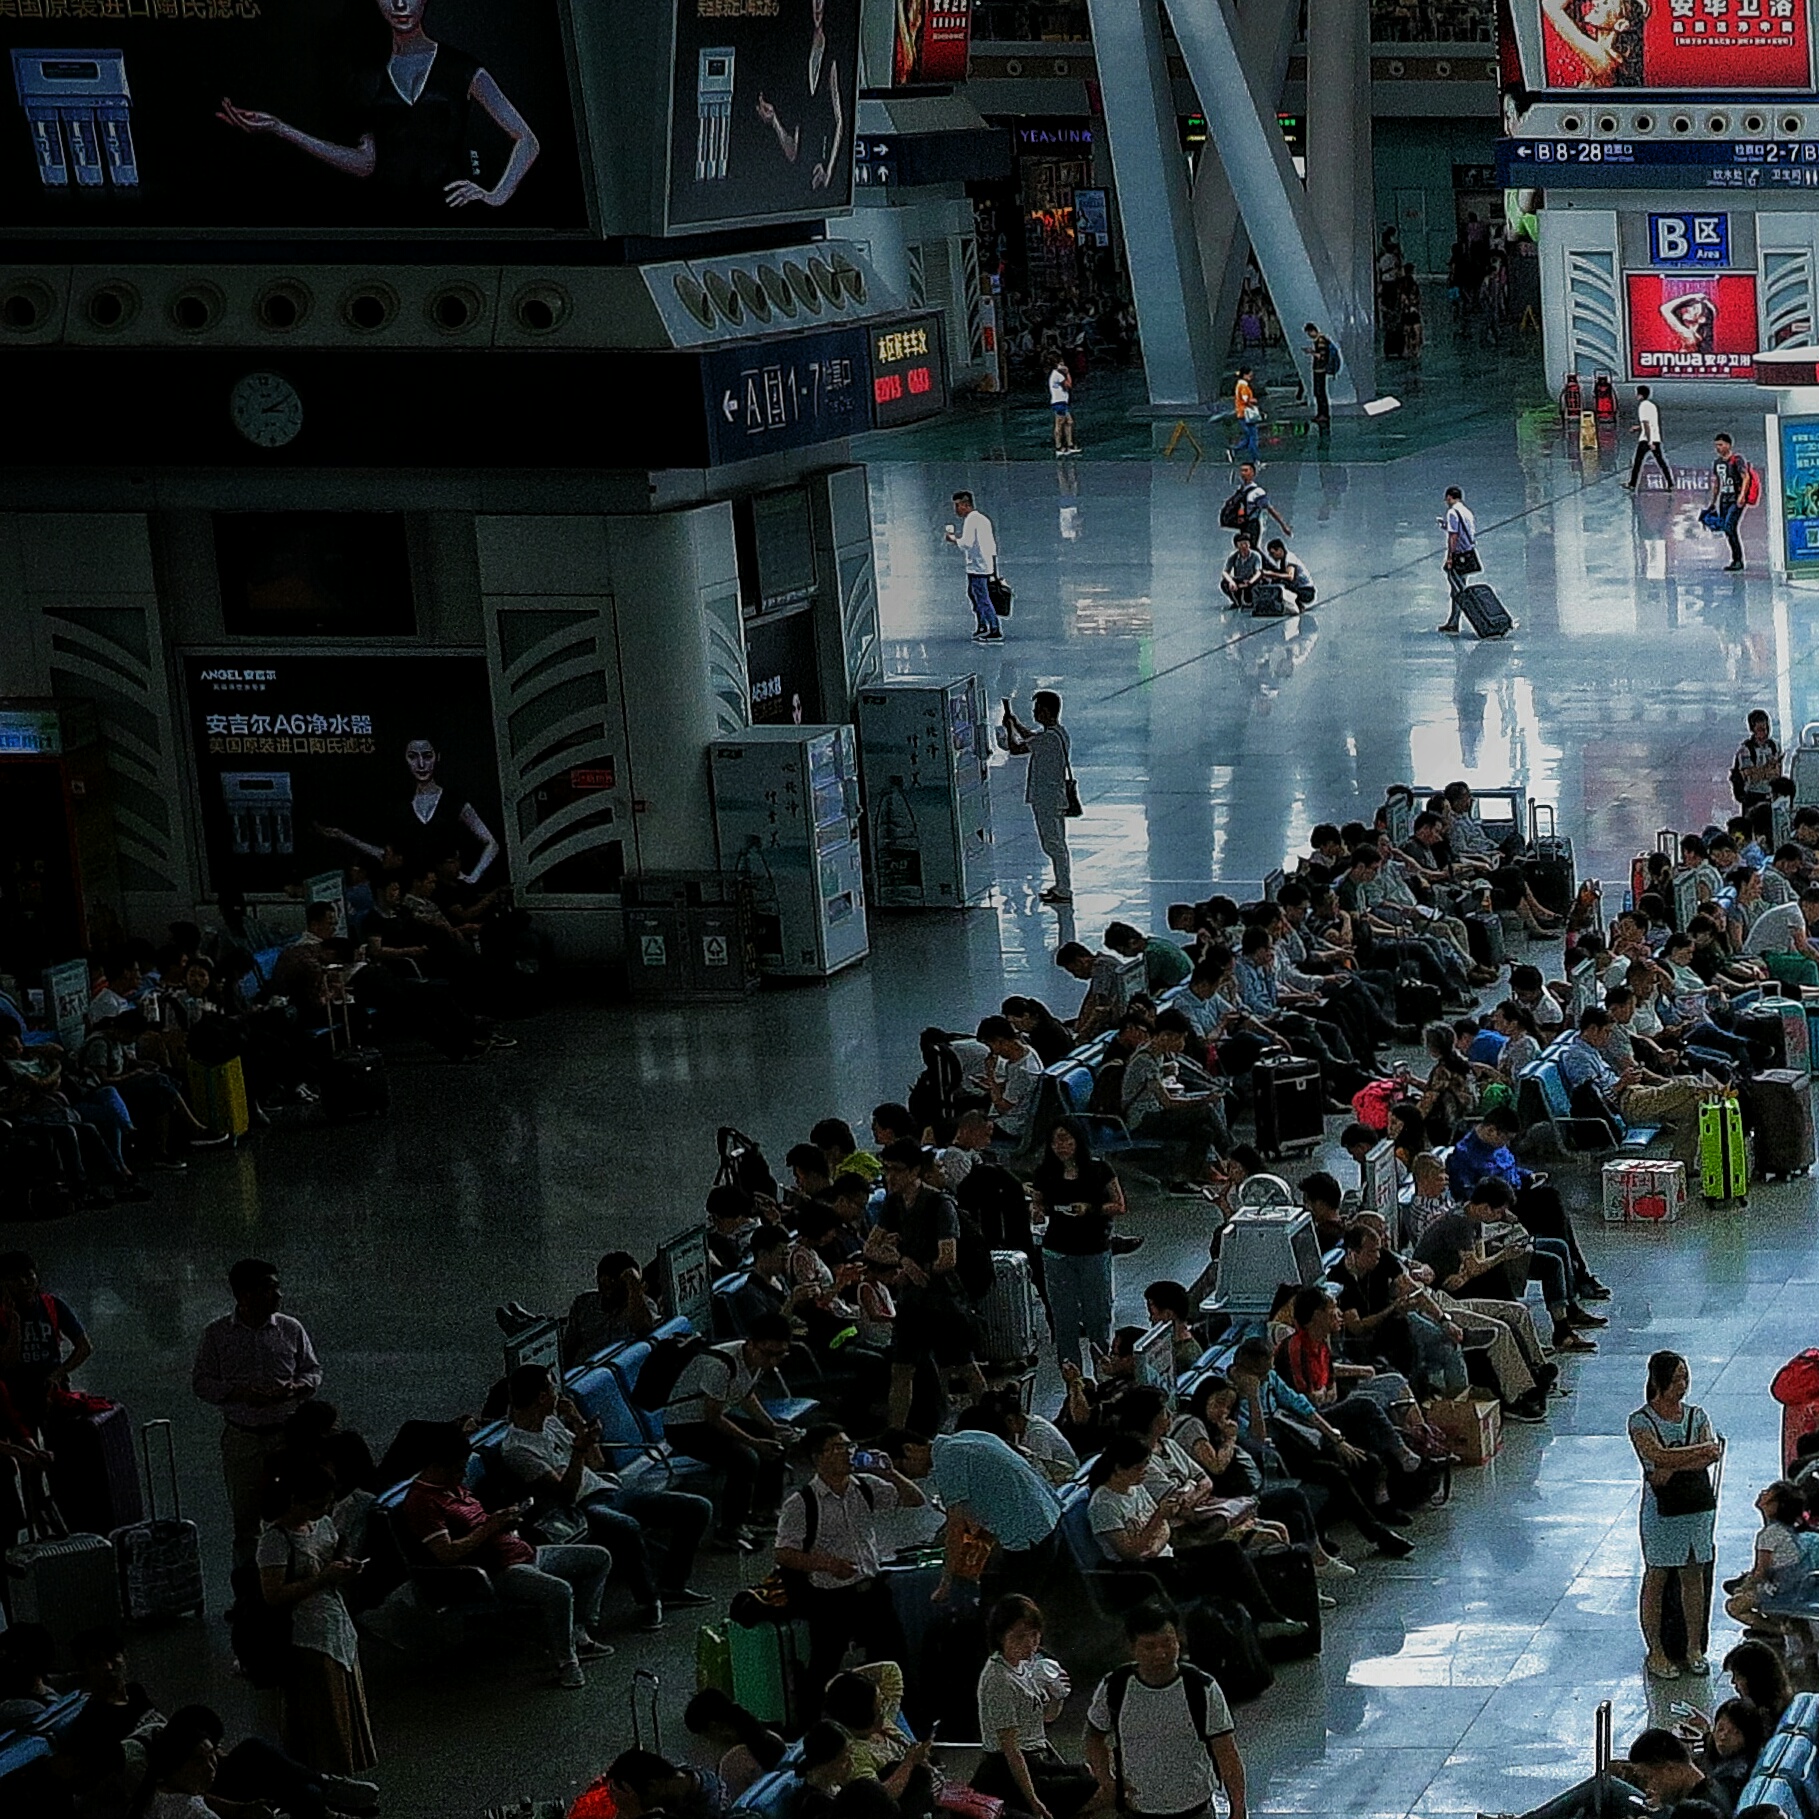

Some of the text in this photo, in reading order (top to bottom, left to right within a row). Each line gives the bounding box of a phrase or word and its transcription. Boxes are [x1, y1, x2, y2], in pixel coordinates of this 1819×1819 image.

[1556, 143, 1602, 162] 8-28
[1766, 143, 1801, 162] 2-7
[1640, 353, 1703, 367] annwa
[200, 669, 243, 680] ANGEL
[205, 713, 373, 735] 安吉尔A6净水器
